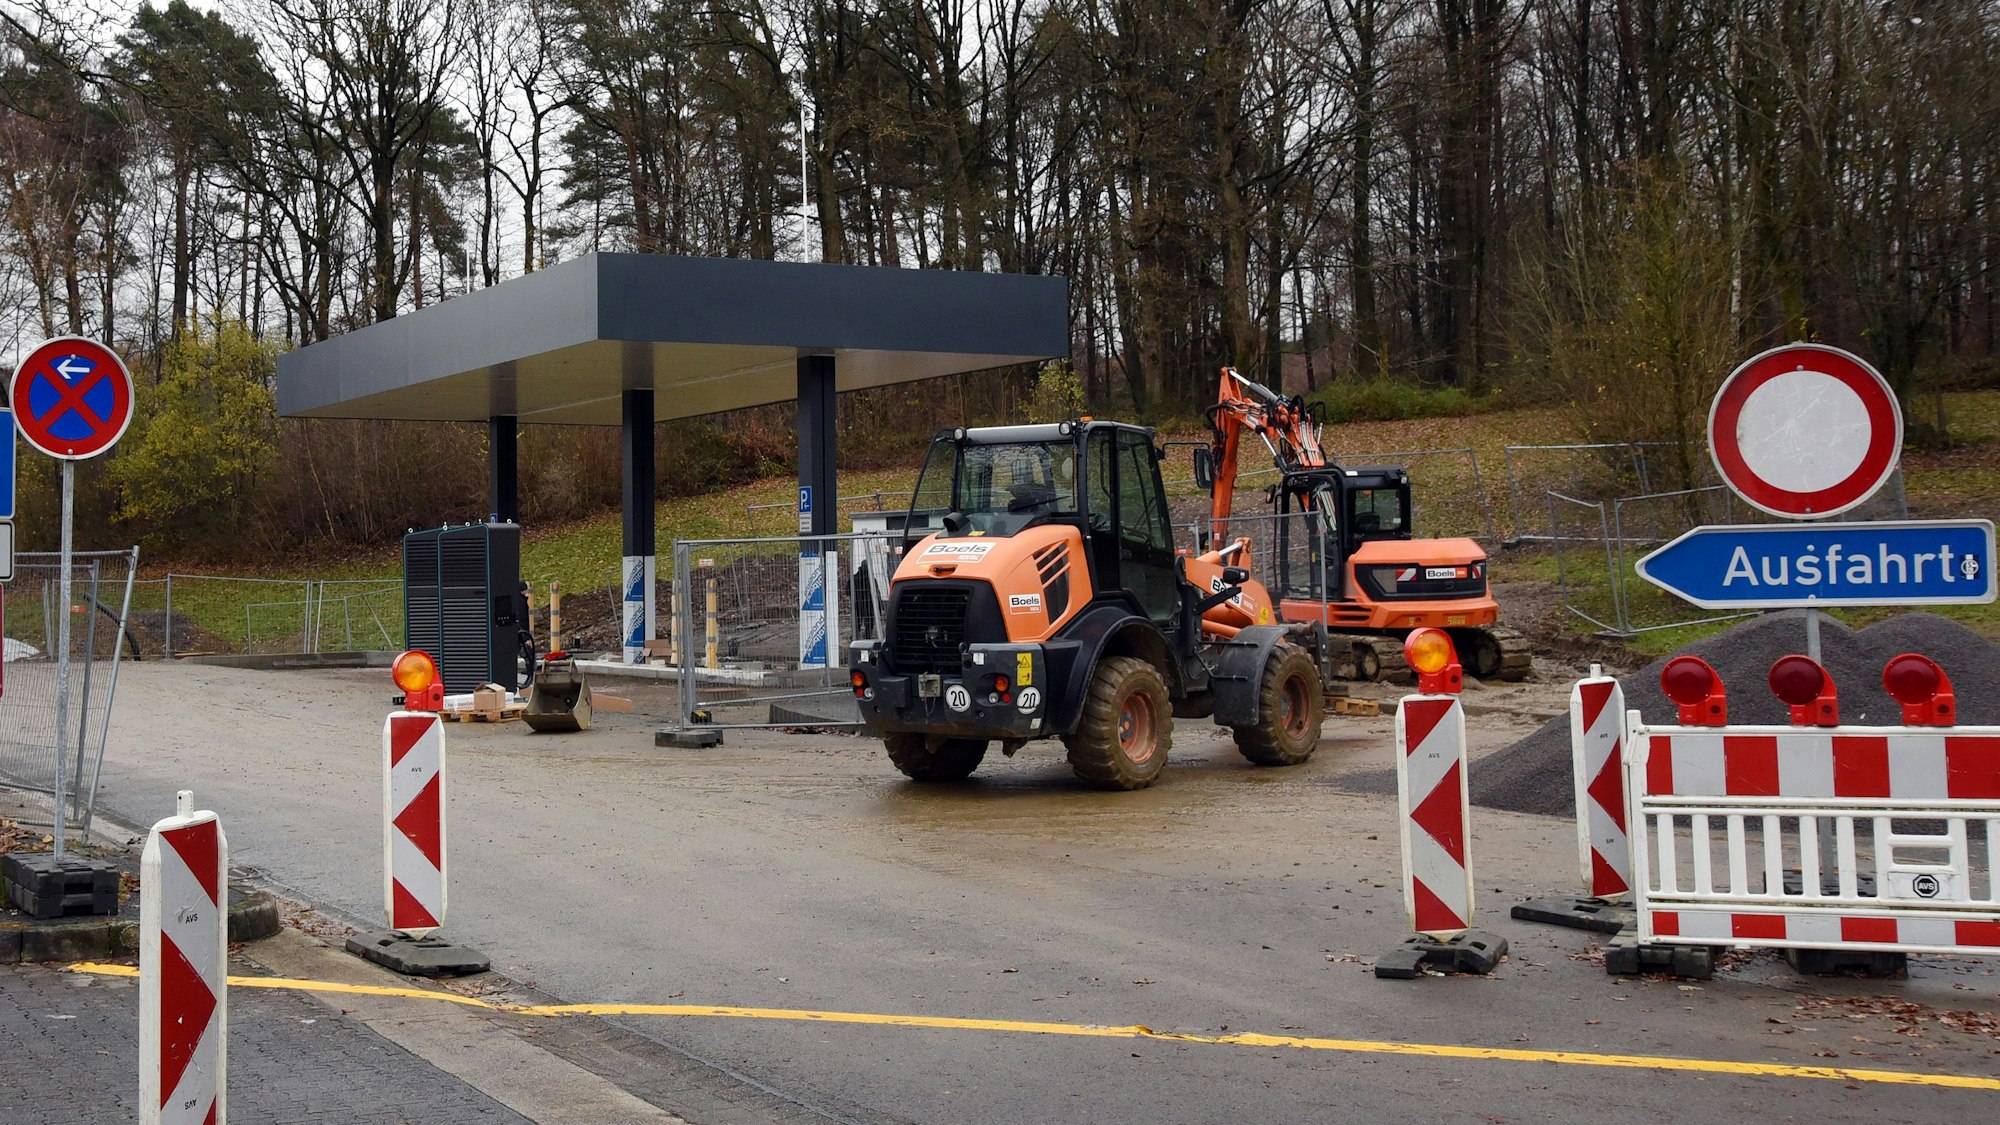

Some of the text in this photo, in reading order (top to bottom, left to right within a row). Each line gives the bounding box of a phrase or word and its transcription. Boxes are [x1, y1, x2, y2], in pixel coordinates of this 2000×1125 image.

[801, 490, 808, 510] P
[928, 544, 988, 553] Boels
[1722, 543, 1956, 586] Ausfahrt
[1427, 570, 1455, 578] Boels
[1011, 597, 1040, 606] Boels
[951, 691, 966, 707] 20
[1022, 693, 1036, 708] 20
[1918, 882, 1935, 891] AVS
[185, 913, 199, 924] AVS
[184, 1098, 197, 1110] AVS
